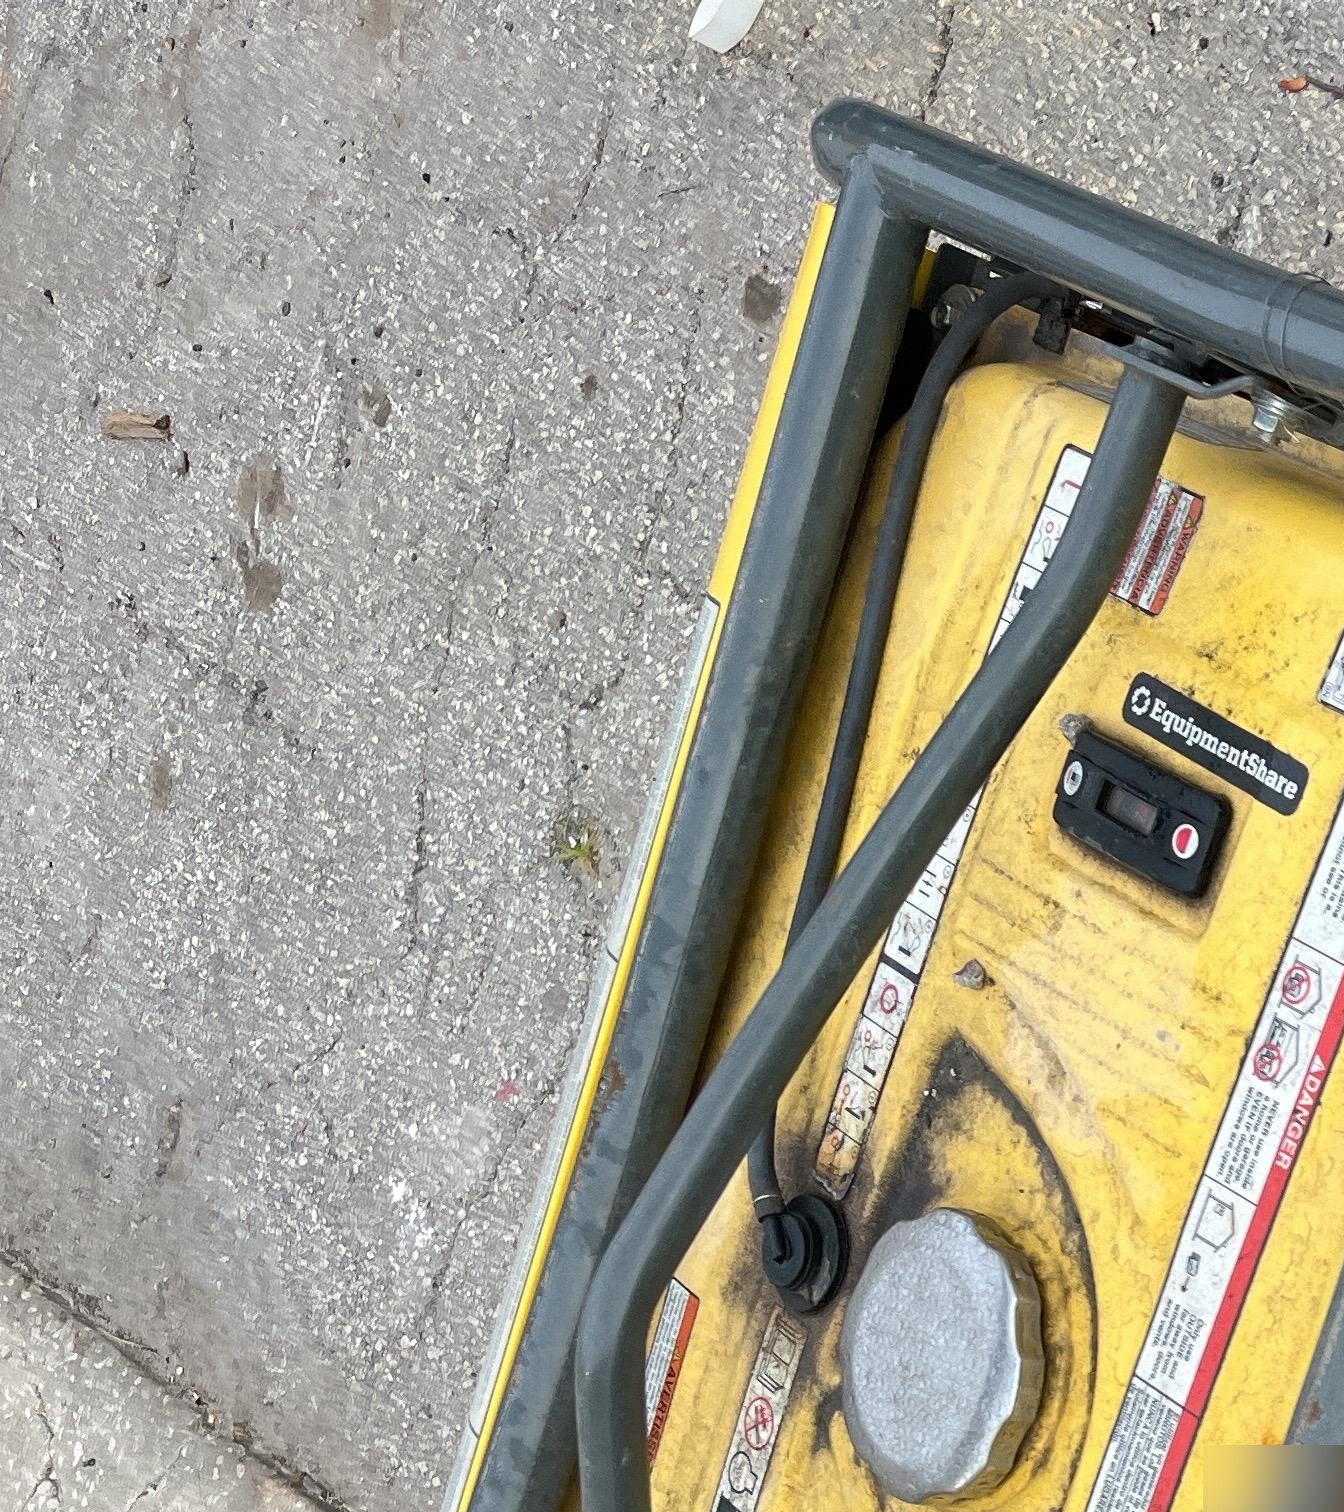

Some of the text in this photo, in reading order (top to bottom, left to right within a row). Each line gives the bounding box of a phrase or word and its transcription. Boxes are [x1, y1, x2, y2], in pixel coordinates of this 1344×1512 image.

[1158, 530, 1190, 593] WARNING
[1149, 698, 1299, 802] EquipmentShare
[1277, 1077, 1322, 1170] DANGER
[647, 1366, 679, 1457] AVERTISS
